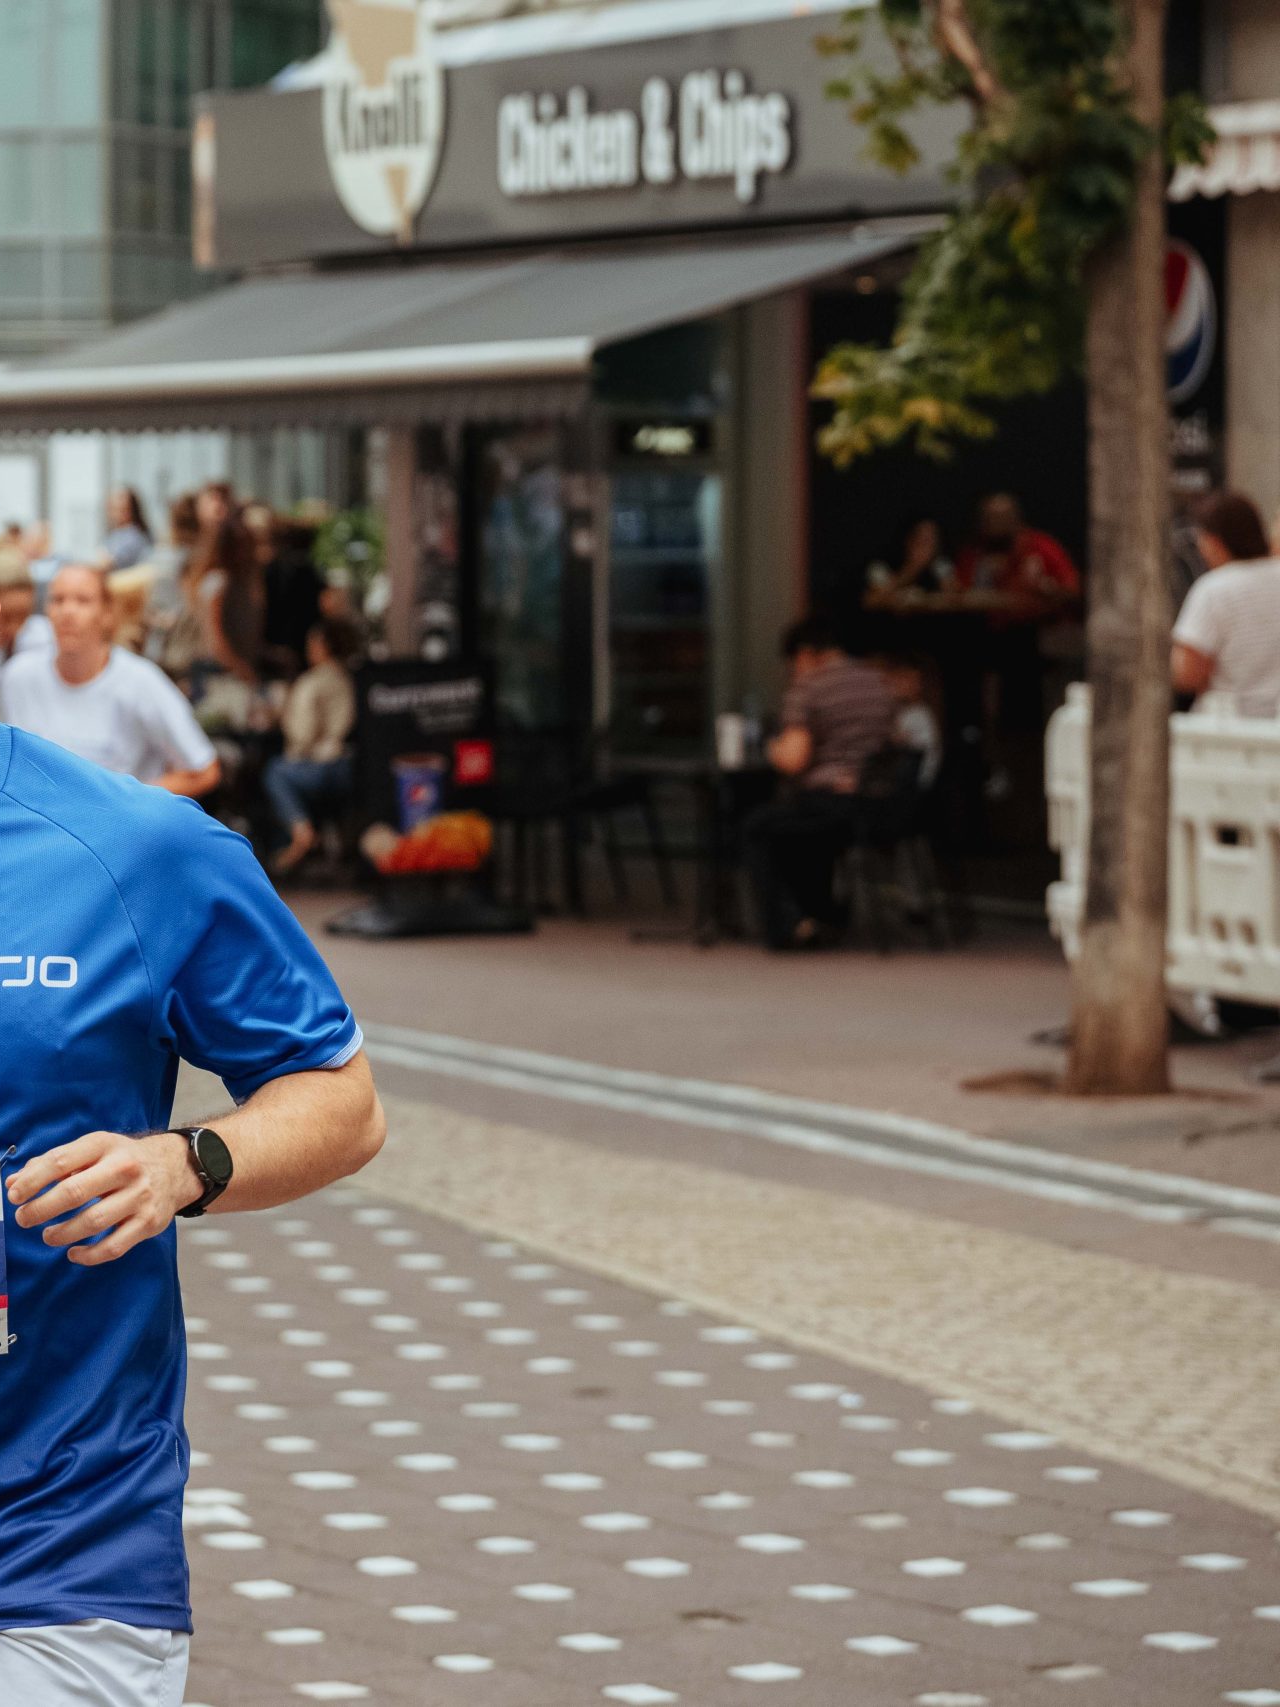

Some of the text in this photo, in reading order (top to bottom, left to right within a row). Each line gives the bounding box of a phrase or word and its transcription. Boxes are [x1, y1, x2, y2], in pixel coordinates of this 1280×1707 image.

[499, 69, 790, 200] Chicken & Chips
